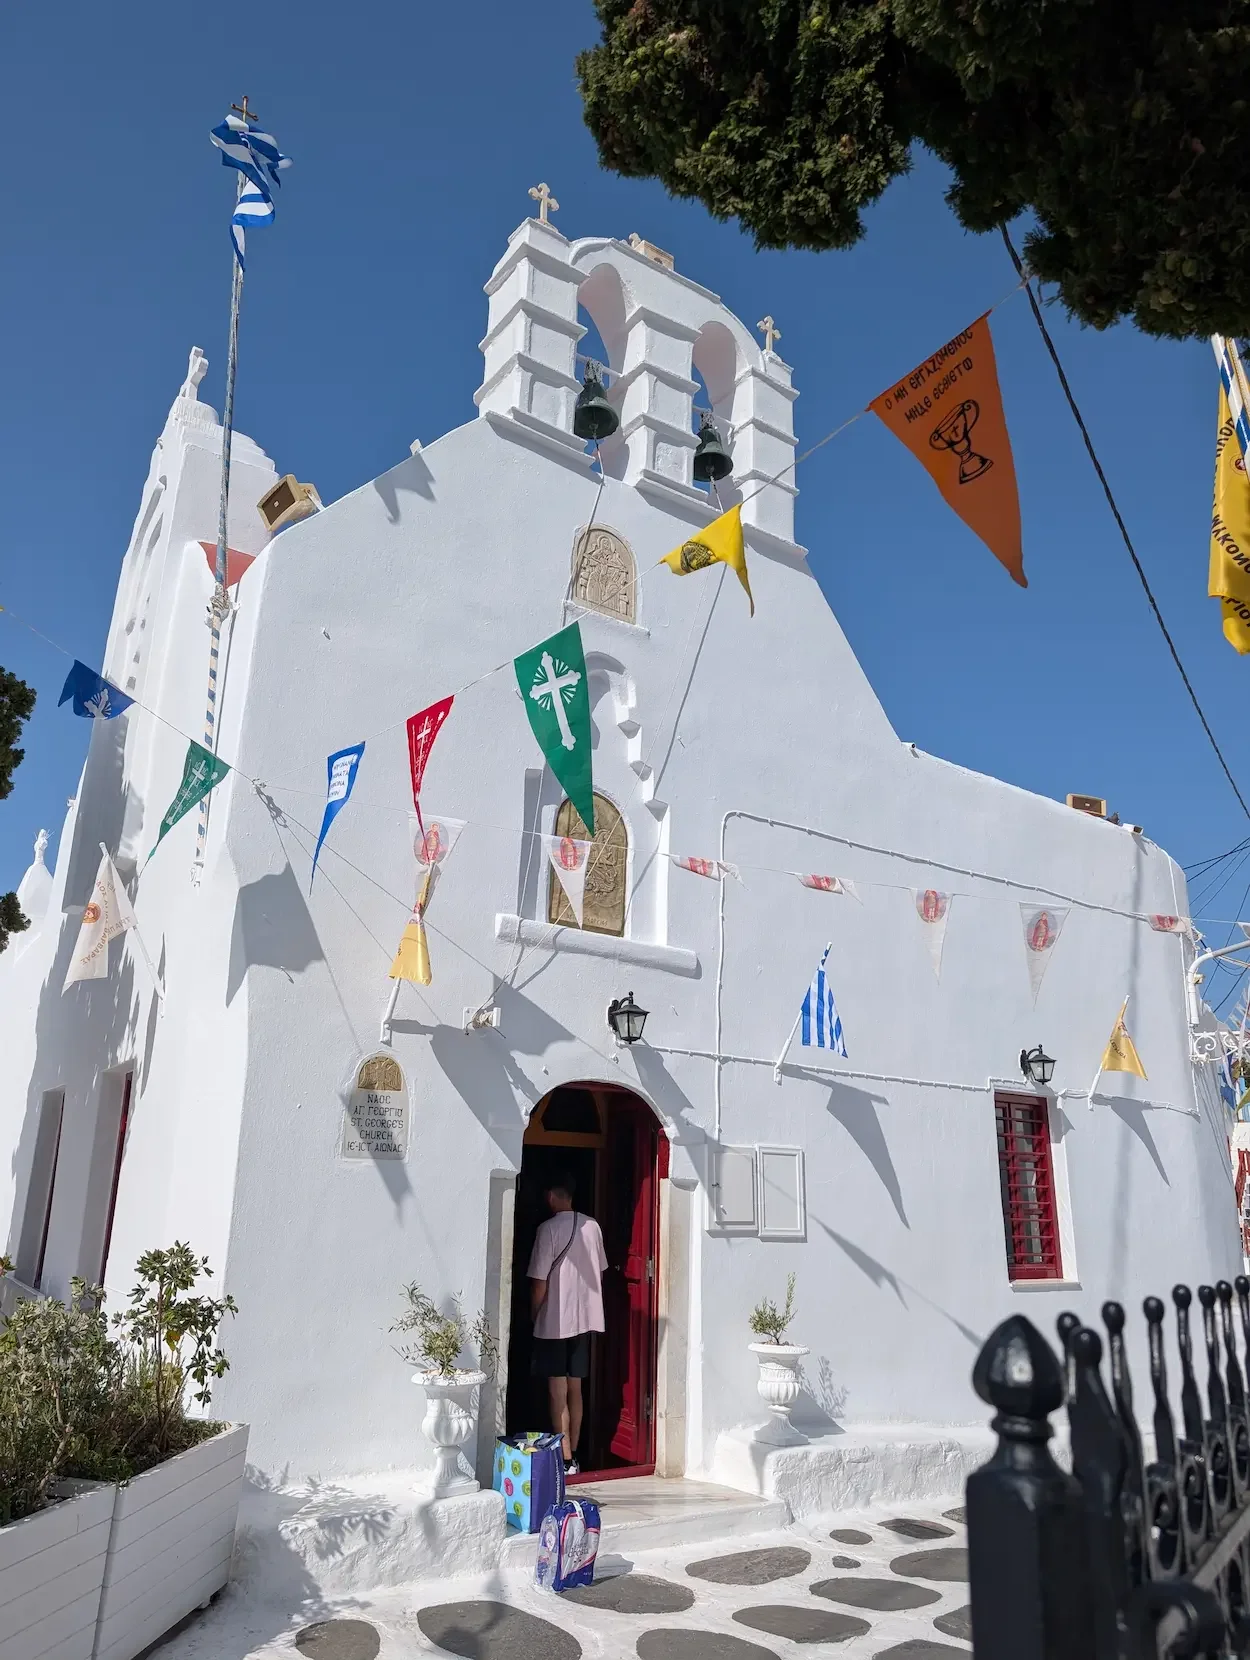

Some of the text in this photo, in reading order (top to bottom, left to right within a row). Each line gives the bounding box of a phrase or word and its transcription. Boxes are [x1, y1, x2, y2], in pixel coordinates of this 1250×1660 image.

[893, 384, 909, 403] ΜΗ
[350, 1117, 404, 1129] ST. GEORGE'S
[359, 1129, 394, 1141] CHURCH
